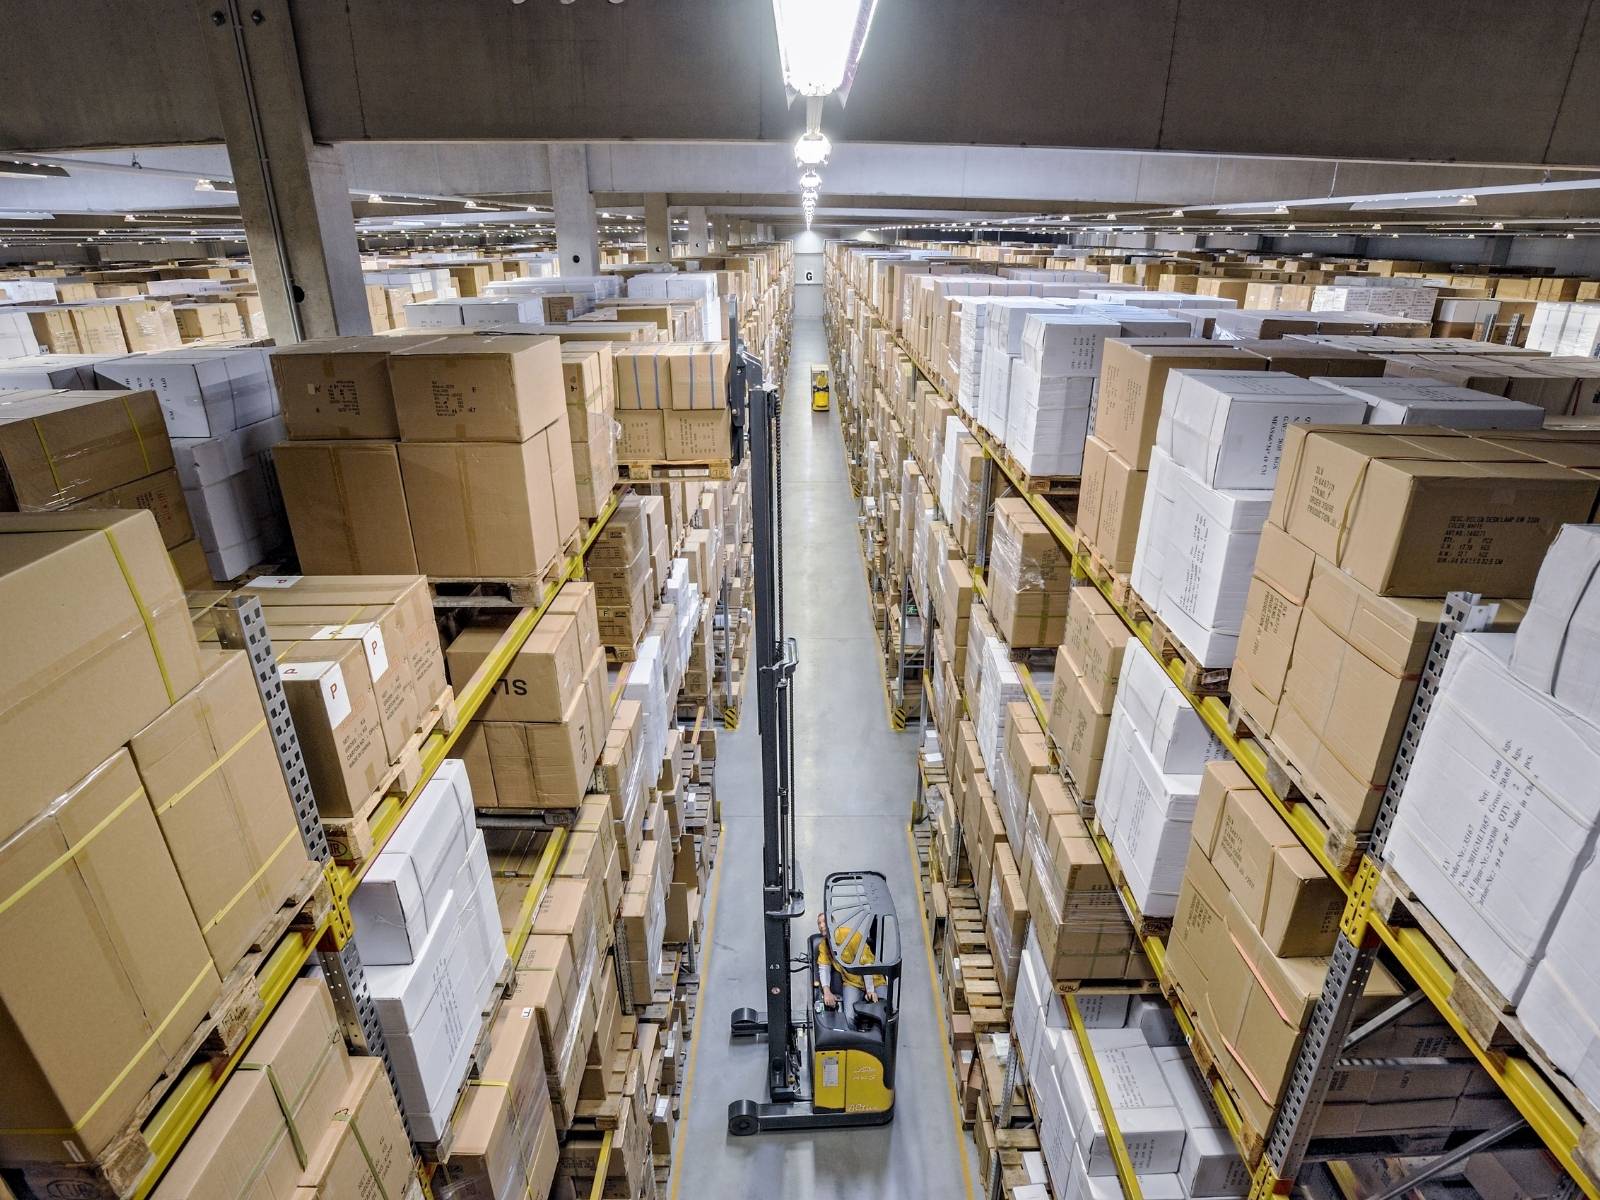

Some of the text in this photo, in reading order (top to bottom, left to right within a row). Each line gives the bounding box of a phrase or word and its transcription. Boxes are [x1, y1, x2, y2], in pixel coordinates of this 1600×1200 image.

[806, 272, 813, 281] G
[372, 640, 378, 655] P
[330, 683, 337, 699] P
